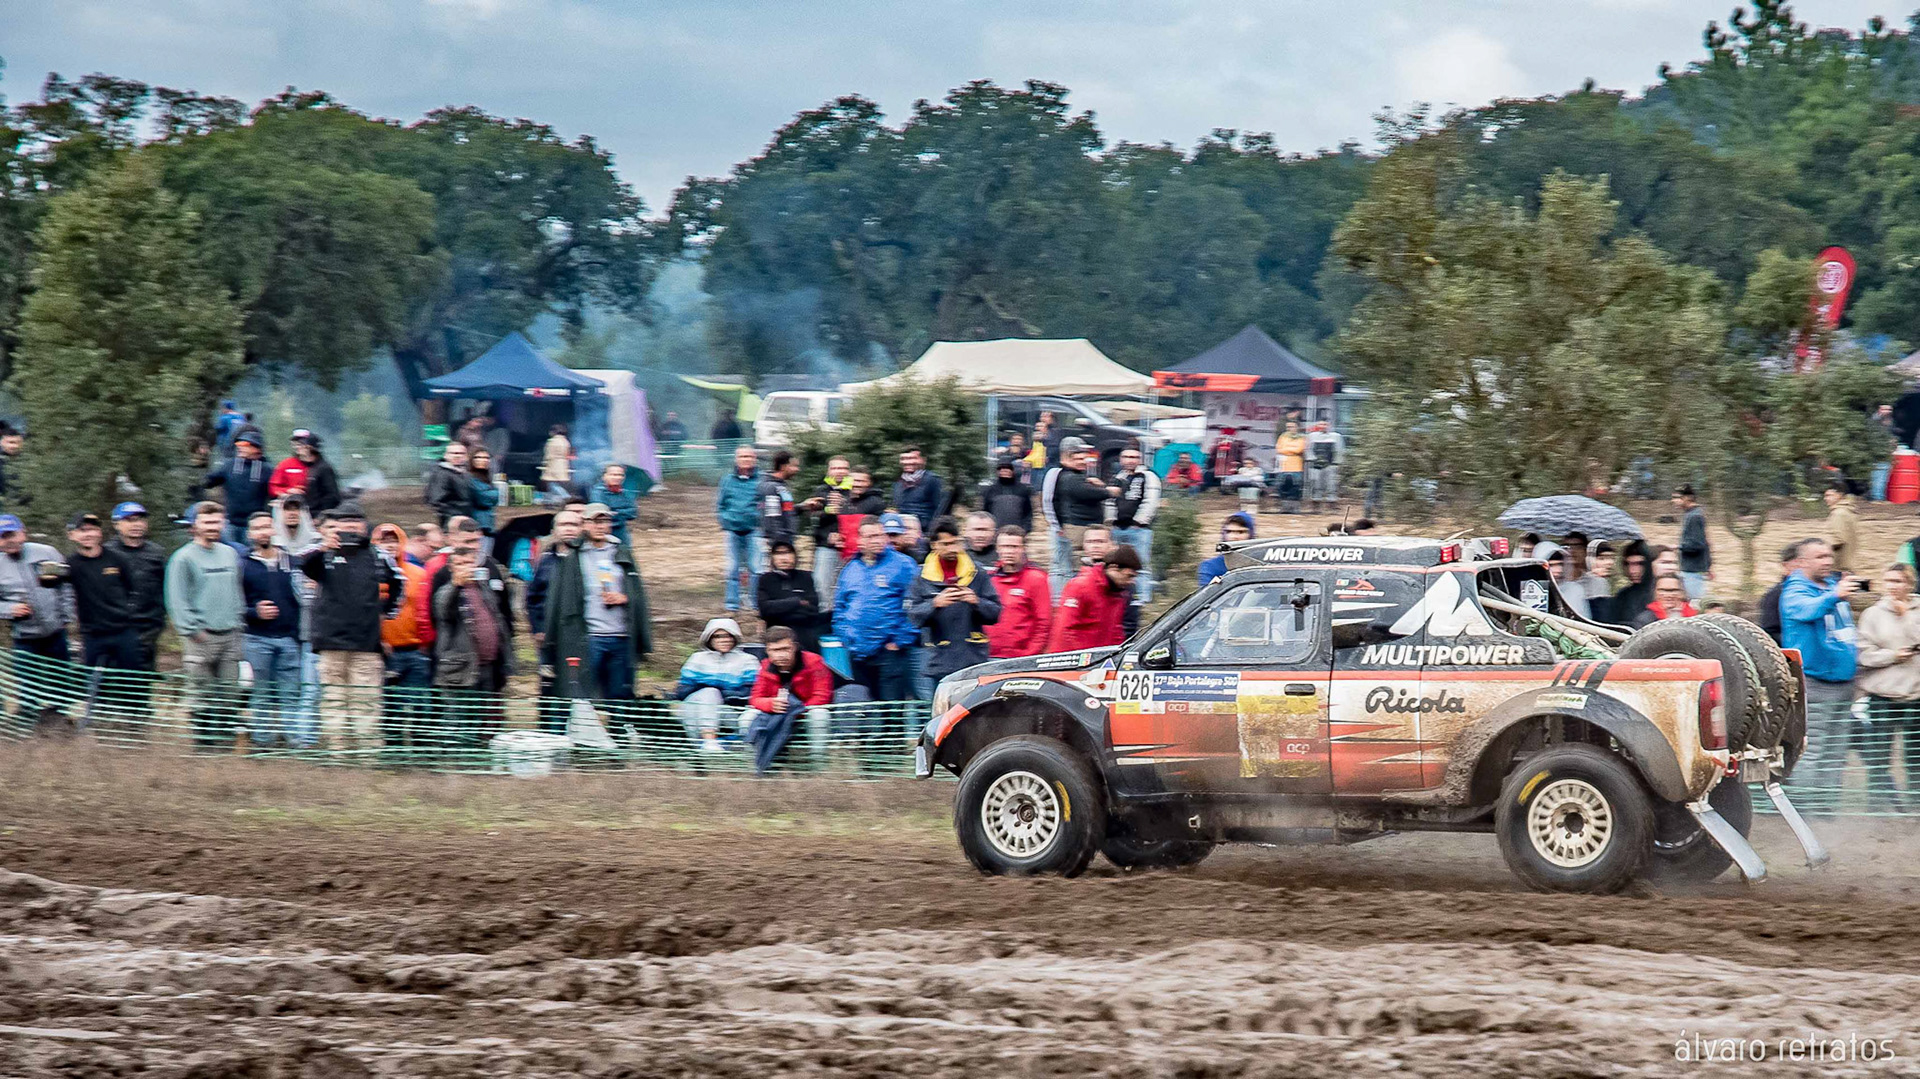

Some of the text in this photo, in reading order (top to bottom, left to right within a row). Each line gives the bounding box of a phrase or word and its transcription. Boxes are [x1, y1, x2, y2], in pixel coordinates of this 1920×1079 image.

[1263, 547, 1364, 561] MULTIPOWER
[1361, 644, 1525, 666] MULTIPOWER
[1120, 674, 1150, 700] 626
[1168, 675, 1183, 687] Baja
[1184, 675, 1223, 688] Portalegre
[1365, 686, 1466, 714] Ricola
[1286, 743, 1310, 755] acp
